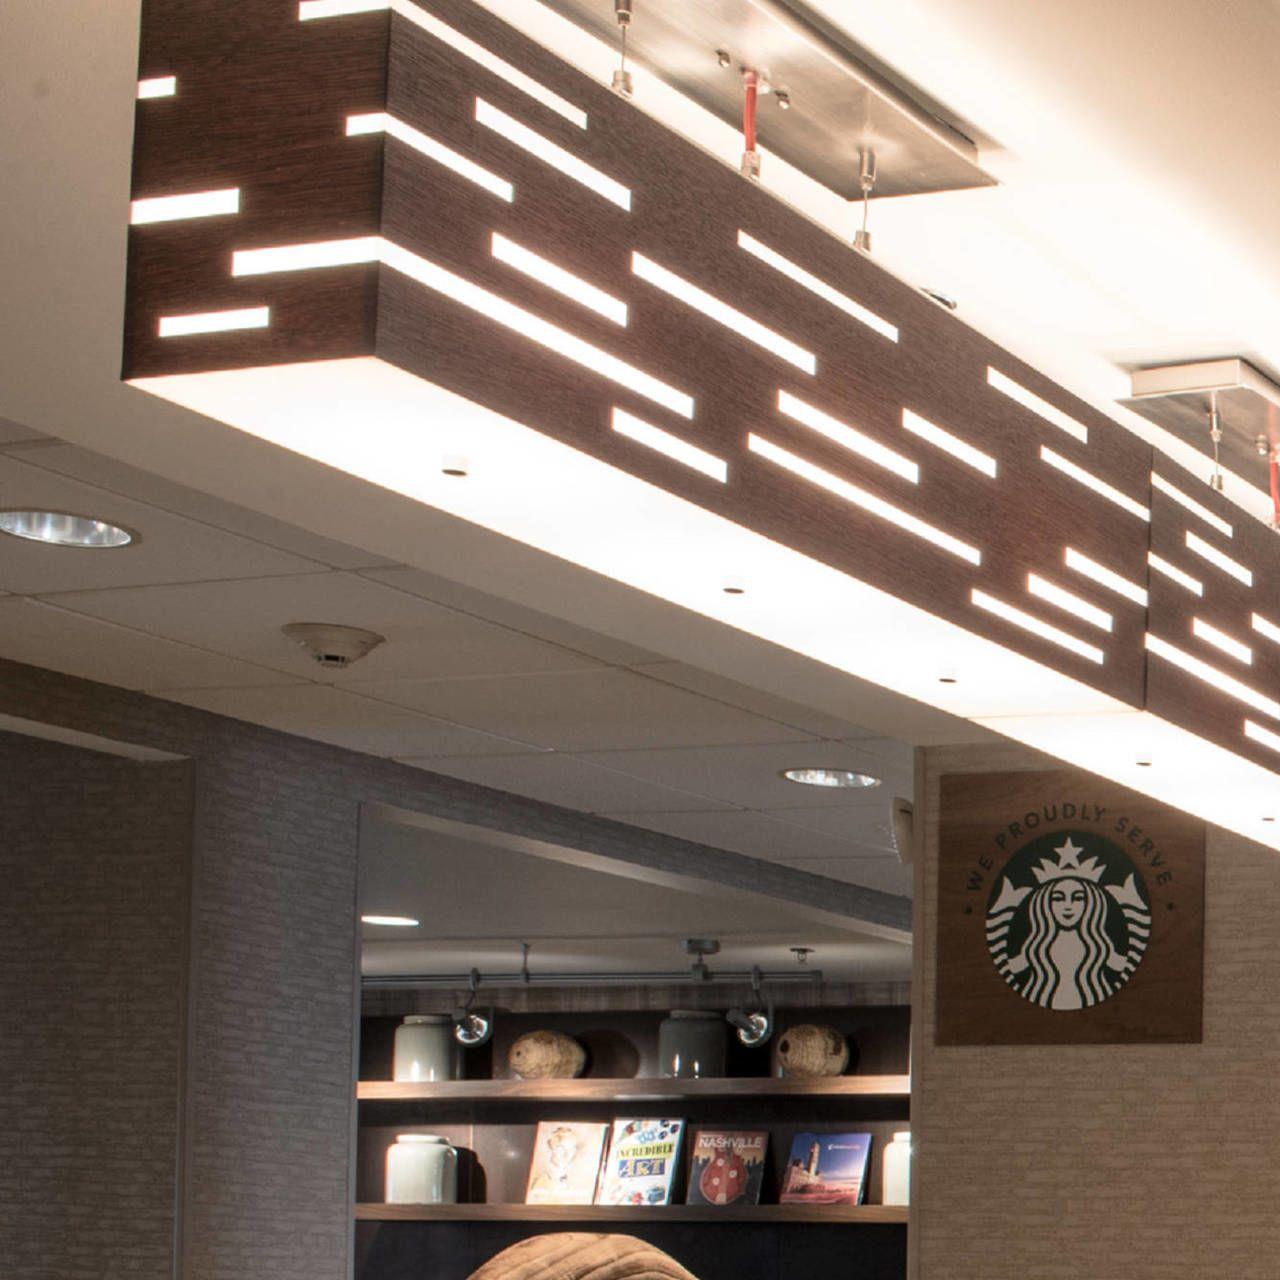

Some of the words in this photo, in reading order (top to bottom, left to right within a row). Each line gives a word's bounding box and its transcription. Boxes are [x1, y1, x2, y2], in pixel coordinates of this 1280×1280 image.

[967, 855, 994, 892] WE
[995, 802, 1106, 848] PROUDLY
[1115, 816, 1173, 885] SERVE
[618, 1142, 674, 1158] INCREDIBLE
[698, 1134, 763, 1149] NASHVILLE
[619, 1158, 665, 1177] ART
